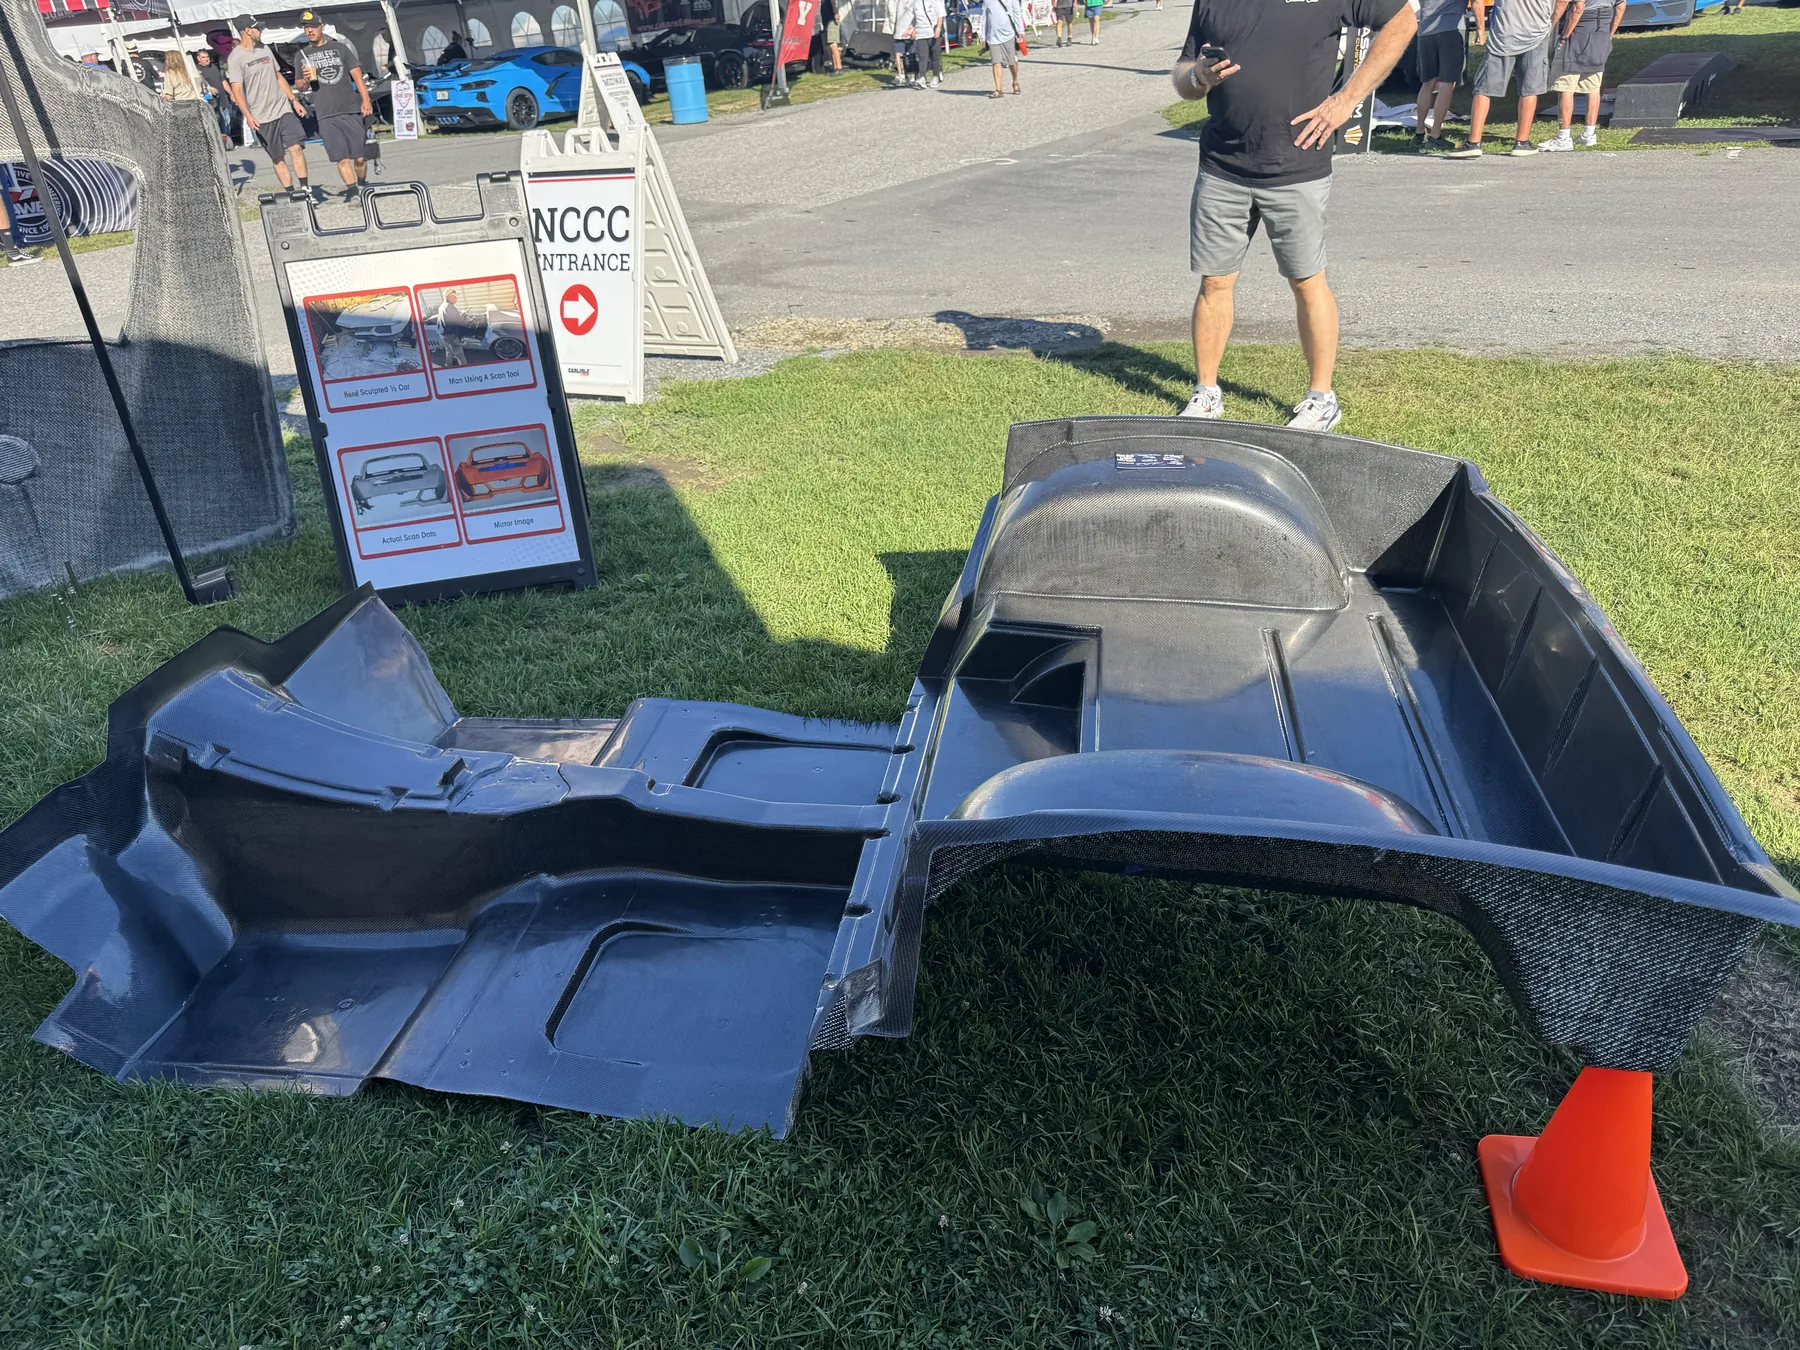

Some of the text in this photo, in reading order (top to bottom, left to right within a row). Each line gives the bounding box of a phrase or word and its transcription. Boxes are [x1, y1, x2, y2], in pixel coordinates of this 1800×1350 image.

[1353, 38, 1361, 70] CUSTO
[532, 205, 630, 243] NCCC
[448, 377, 464, 385] Man
[464, 375, 483, 383] Using
[489, 372, 506, 380] Scan
[506, 370, 520, 378] Tool
[343, 390, 359, 398] Hand
[360, 386, 389, 396] Sculpted
[514, 518, 534, 526] Image
[382, 531, 437, 544] Actual Scan Data
